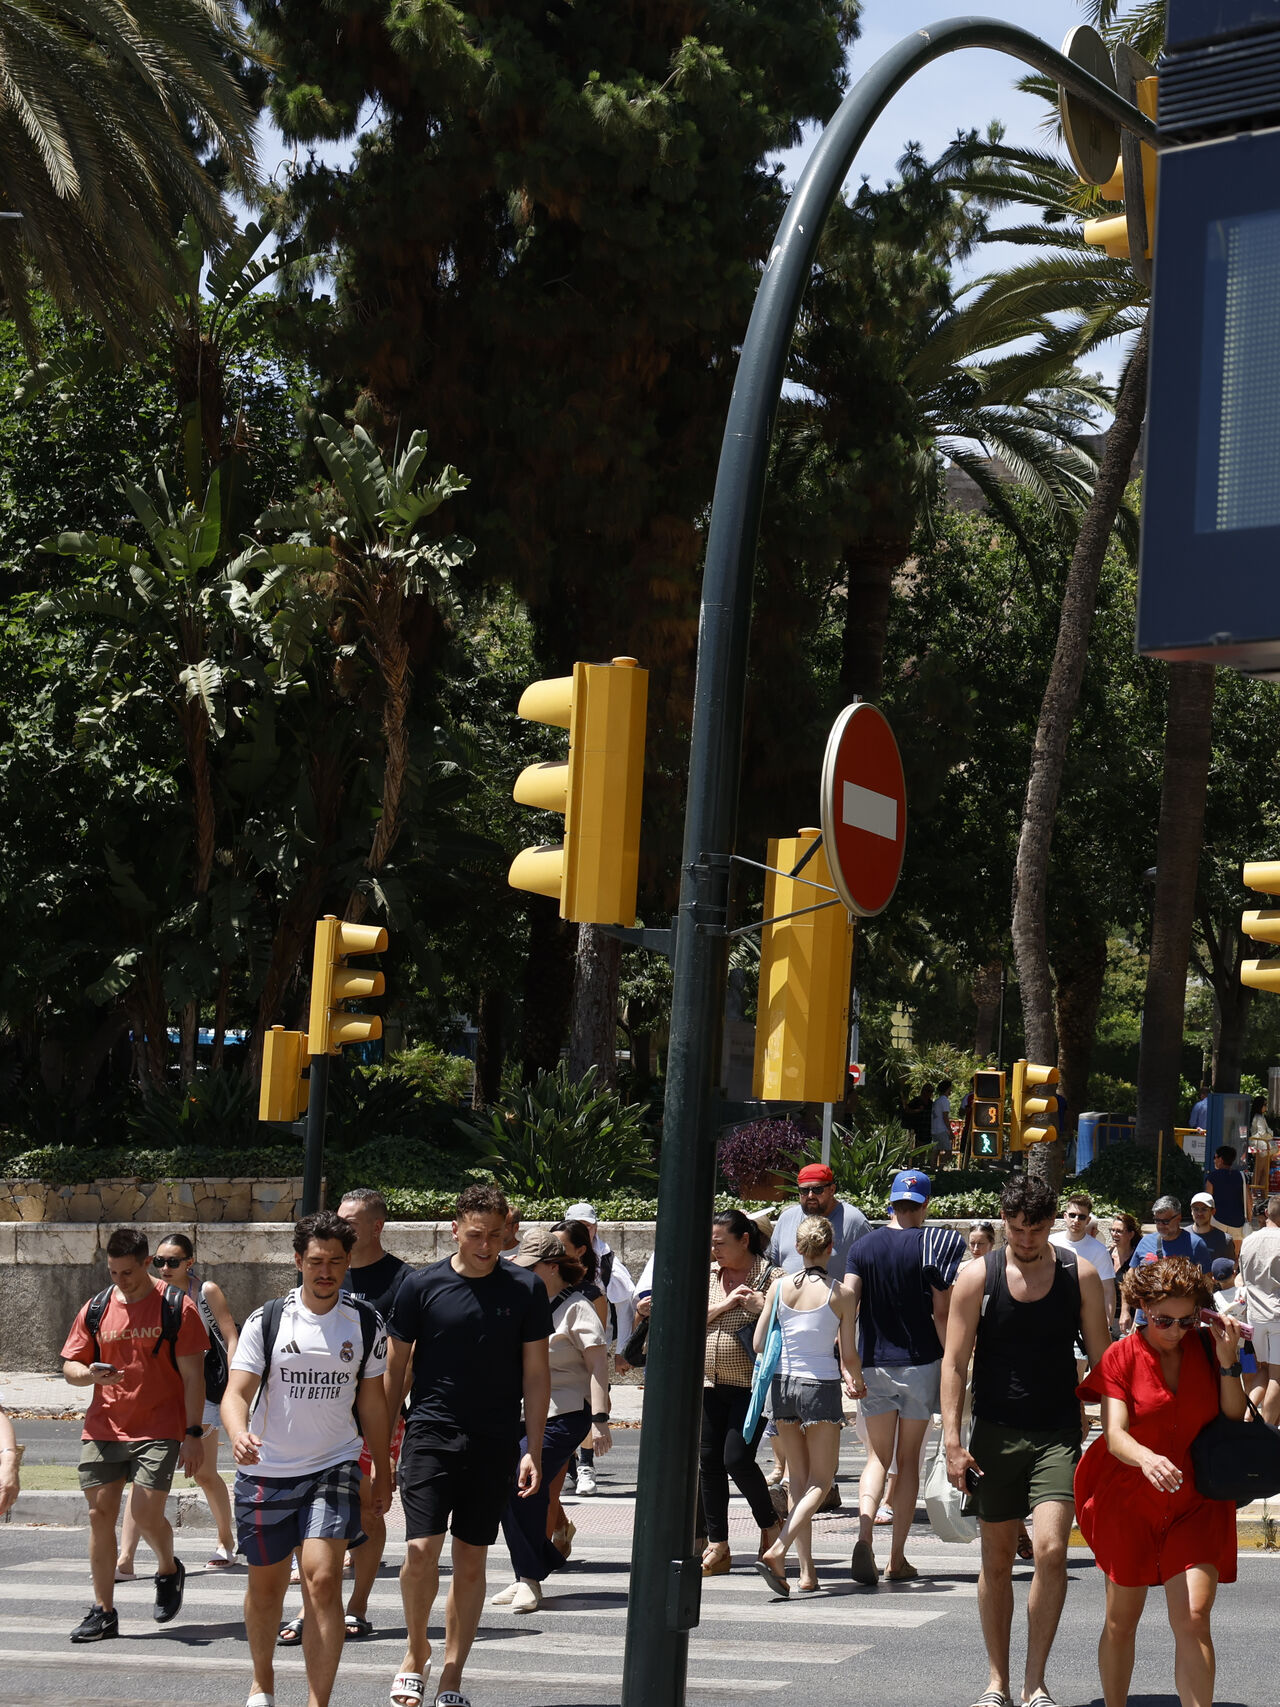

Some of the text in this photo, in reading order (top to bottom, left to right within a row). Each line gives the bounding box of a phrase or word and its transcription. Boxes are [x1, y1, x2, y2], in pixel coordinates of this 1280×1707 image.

[988, 1106, 997, 1124] 9
[280, 1367, 352, 1385] Emirates
[289, 1386, 341, 1400] FLY BETTER
